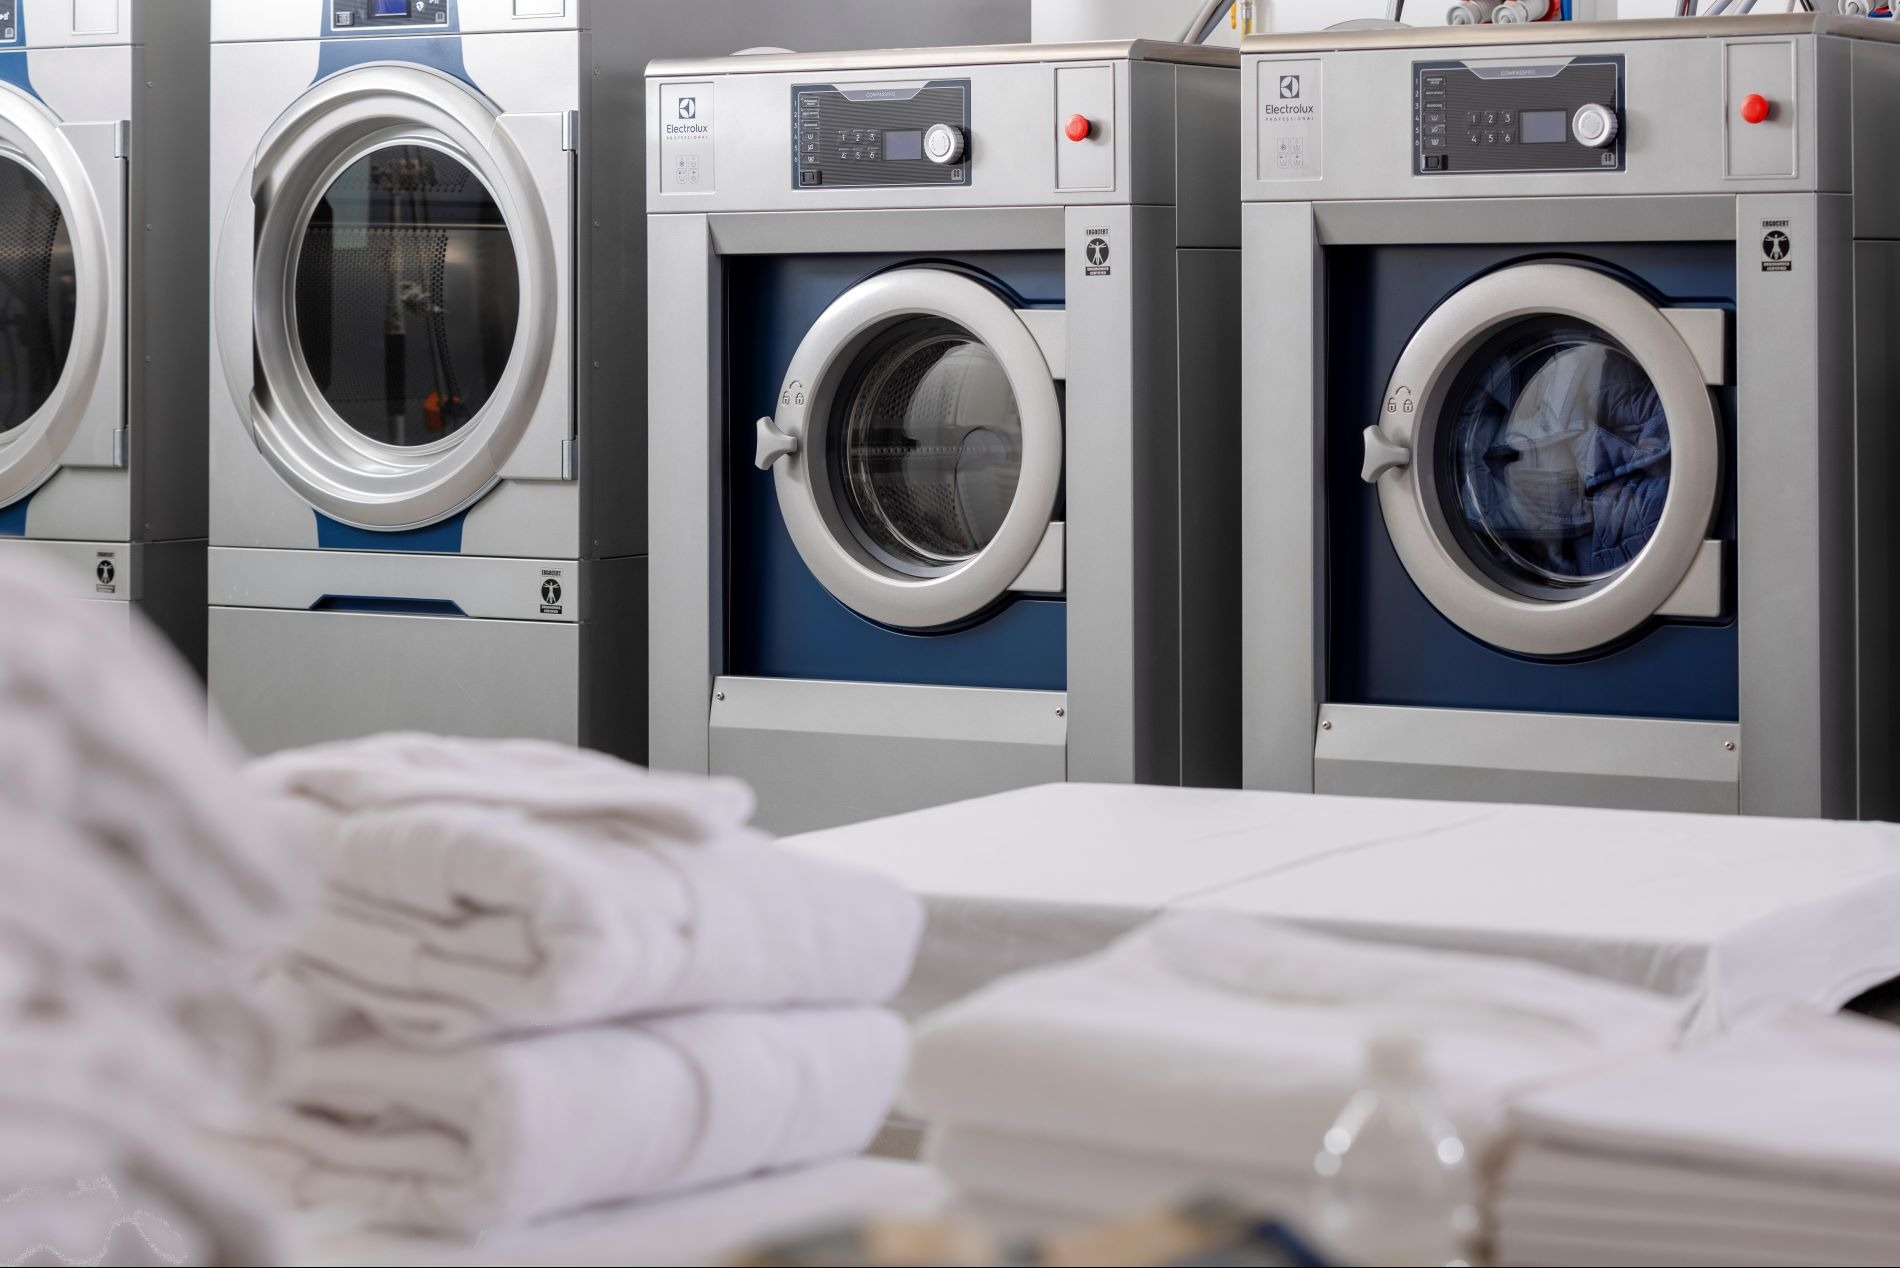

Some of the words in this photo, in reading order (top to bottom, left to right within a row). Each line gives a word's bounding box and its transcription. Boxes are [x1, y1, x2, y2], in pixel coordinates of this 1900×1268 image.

[1265, 103, 1314, 114] Electrolux
[1488, 115, 1493, 123] 2
[1505, 114, 1511, 122] 3
[666, 124, 708, 133] Electrolux
[1488, 134, 1493, 142] 5
[1505, 134, 1510, 142] 6
